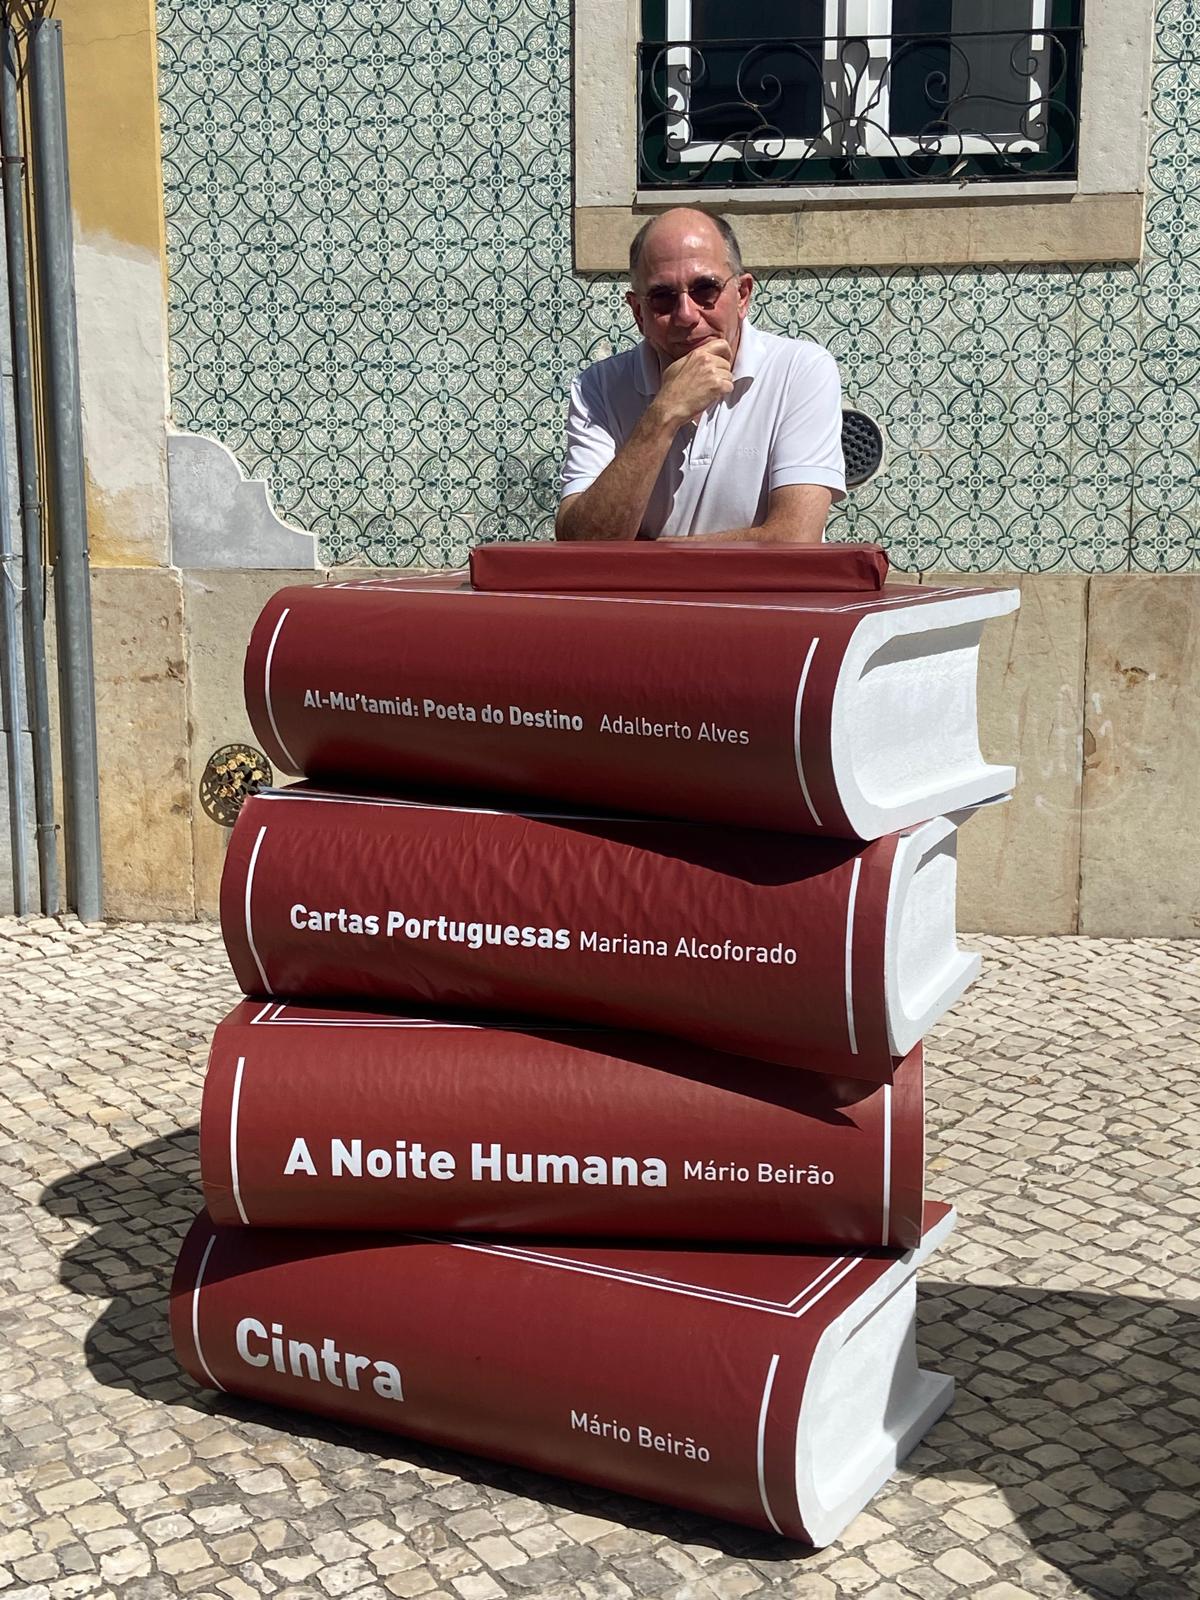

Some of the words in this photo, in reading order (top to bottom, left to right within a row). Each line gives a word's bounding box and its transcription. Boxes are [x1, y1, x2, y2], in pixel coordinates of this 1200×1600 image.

[423, 699, 477, 722] Poeta
[481, 704, 504, 724] do
[509, 705, 583, 731] Destino
[599, 714, 692, 740] Adalberto
[697, 722, 750, 745] Alves
[290, 903, 380, 936] Cartas
[386, 910, 571, 950] Portuguesas
[579, 930, 668, 957] Mariana
[674, 936, 797, 965] Alcoforado
[283, 1137, 318, 1176] A
[331, 1138, 456, 1180] Noite
[471, 1142, 668, 1188] Humana
[684, 1159, 750, 1182] Mário
[757, 1162, 835, 1185] Beirão
[235, 1317, 404, 1402] Cintra
[570, 1409, 631, 1443] Mário
[638, 1425, 710, 1463] Beirão
